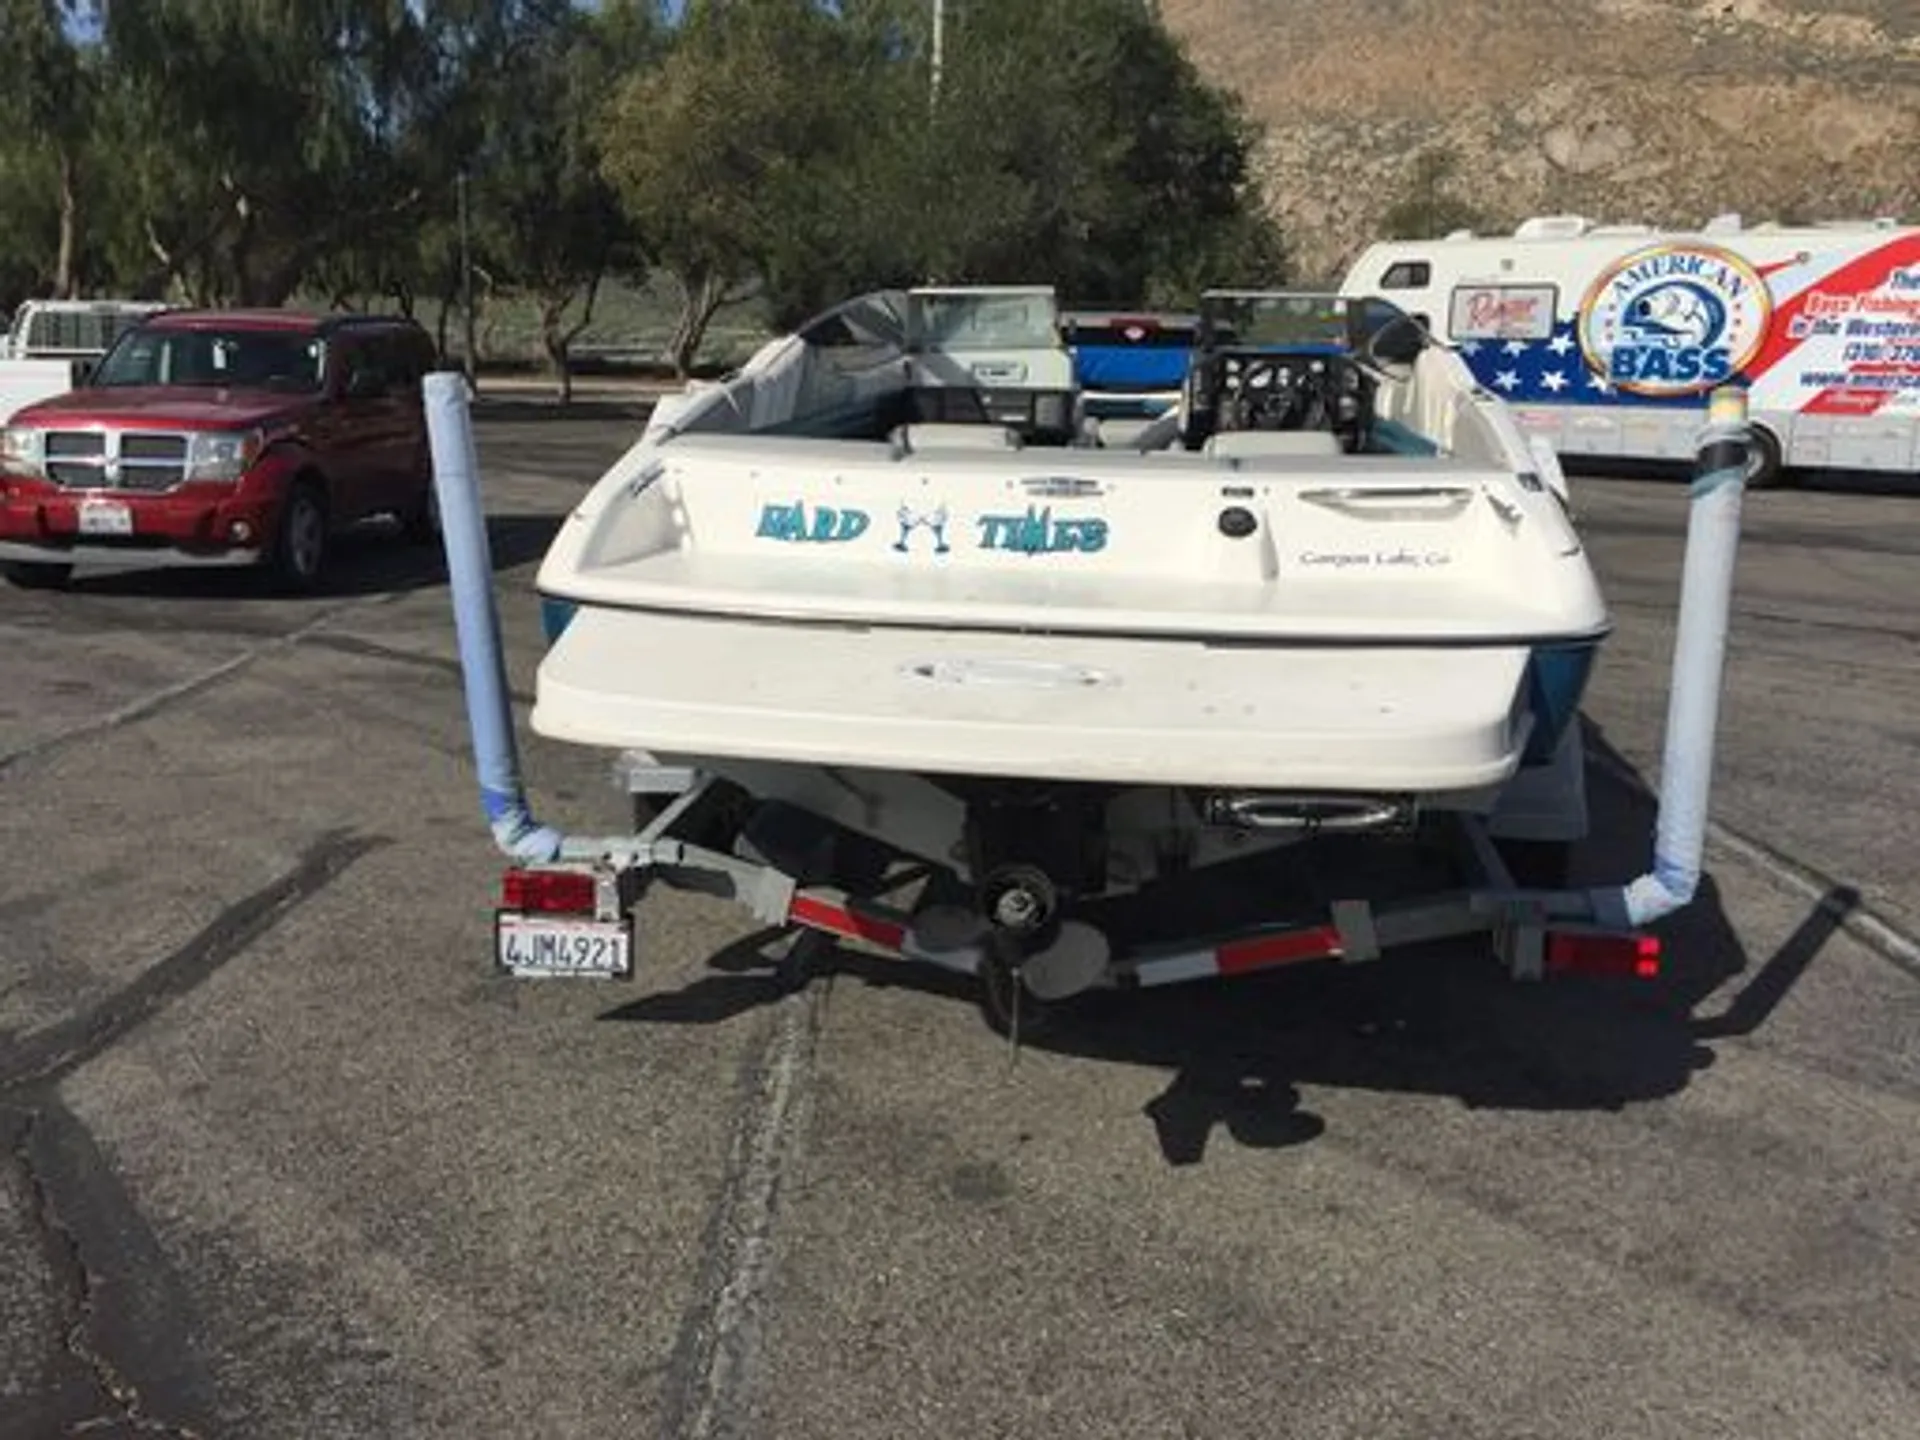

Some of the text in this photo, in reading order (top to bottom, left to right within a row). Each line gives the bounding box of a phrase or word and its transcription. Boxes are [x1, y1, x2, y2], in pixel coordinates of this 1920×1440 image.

[1614, 254, 1743, 297] AMERICAN
[1612, 346, 1731, 379] BASS
[755, 499, 1109, 557] HARD TIMES
[505, 933, 625, 969] 4JM4921
